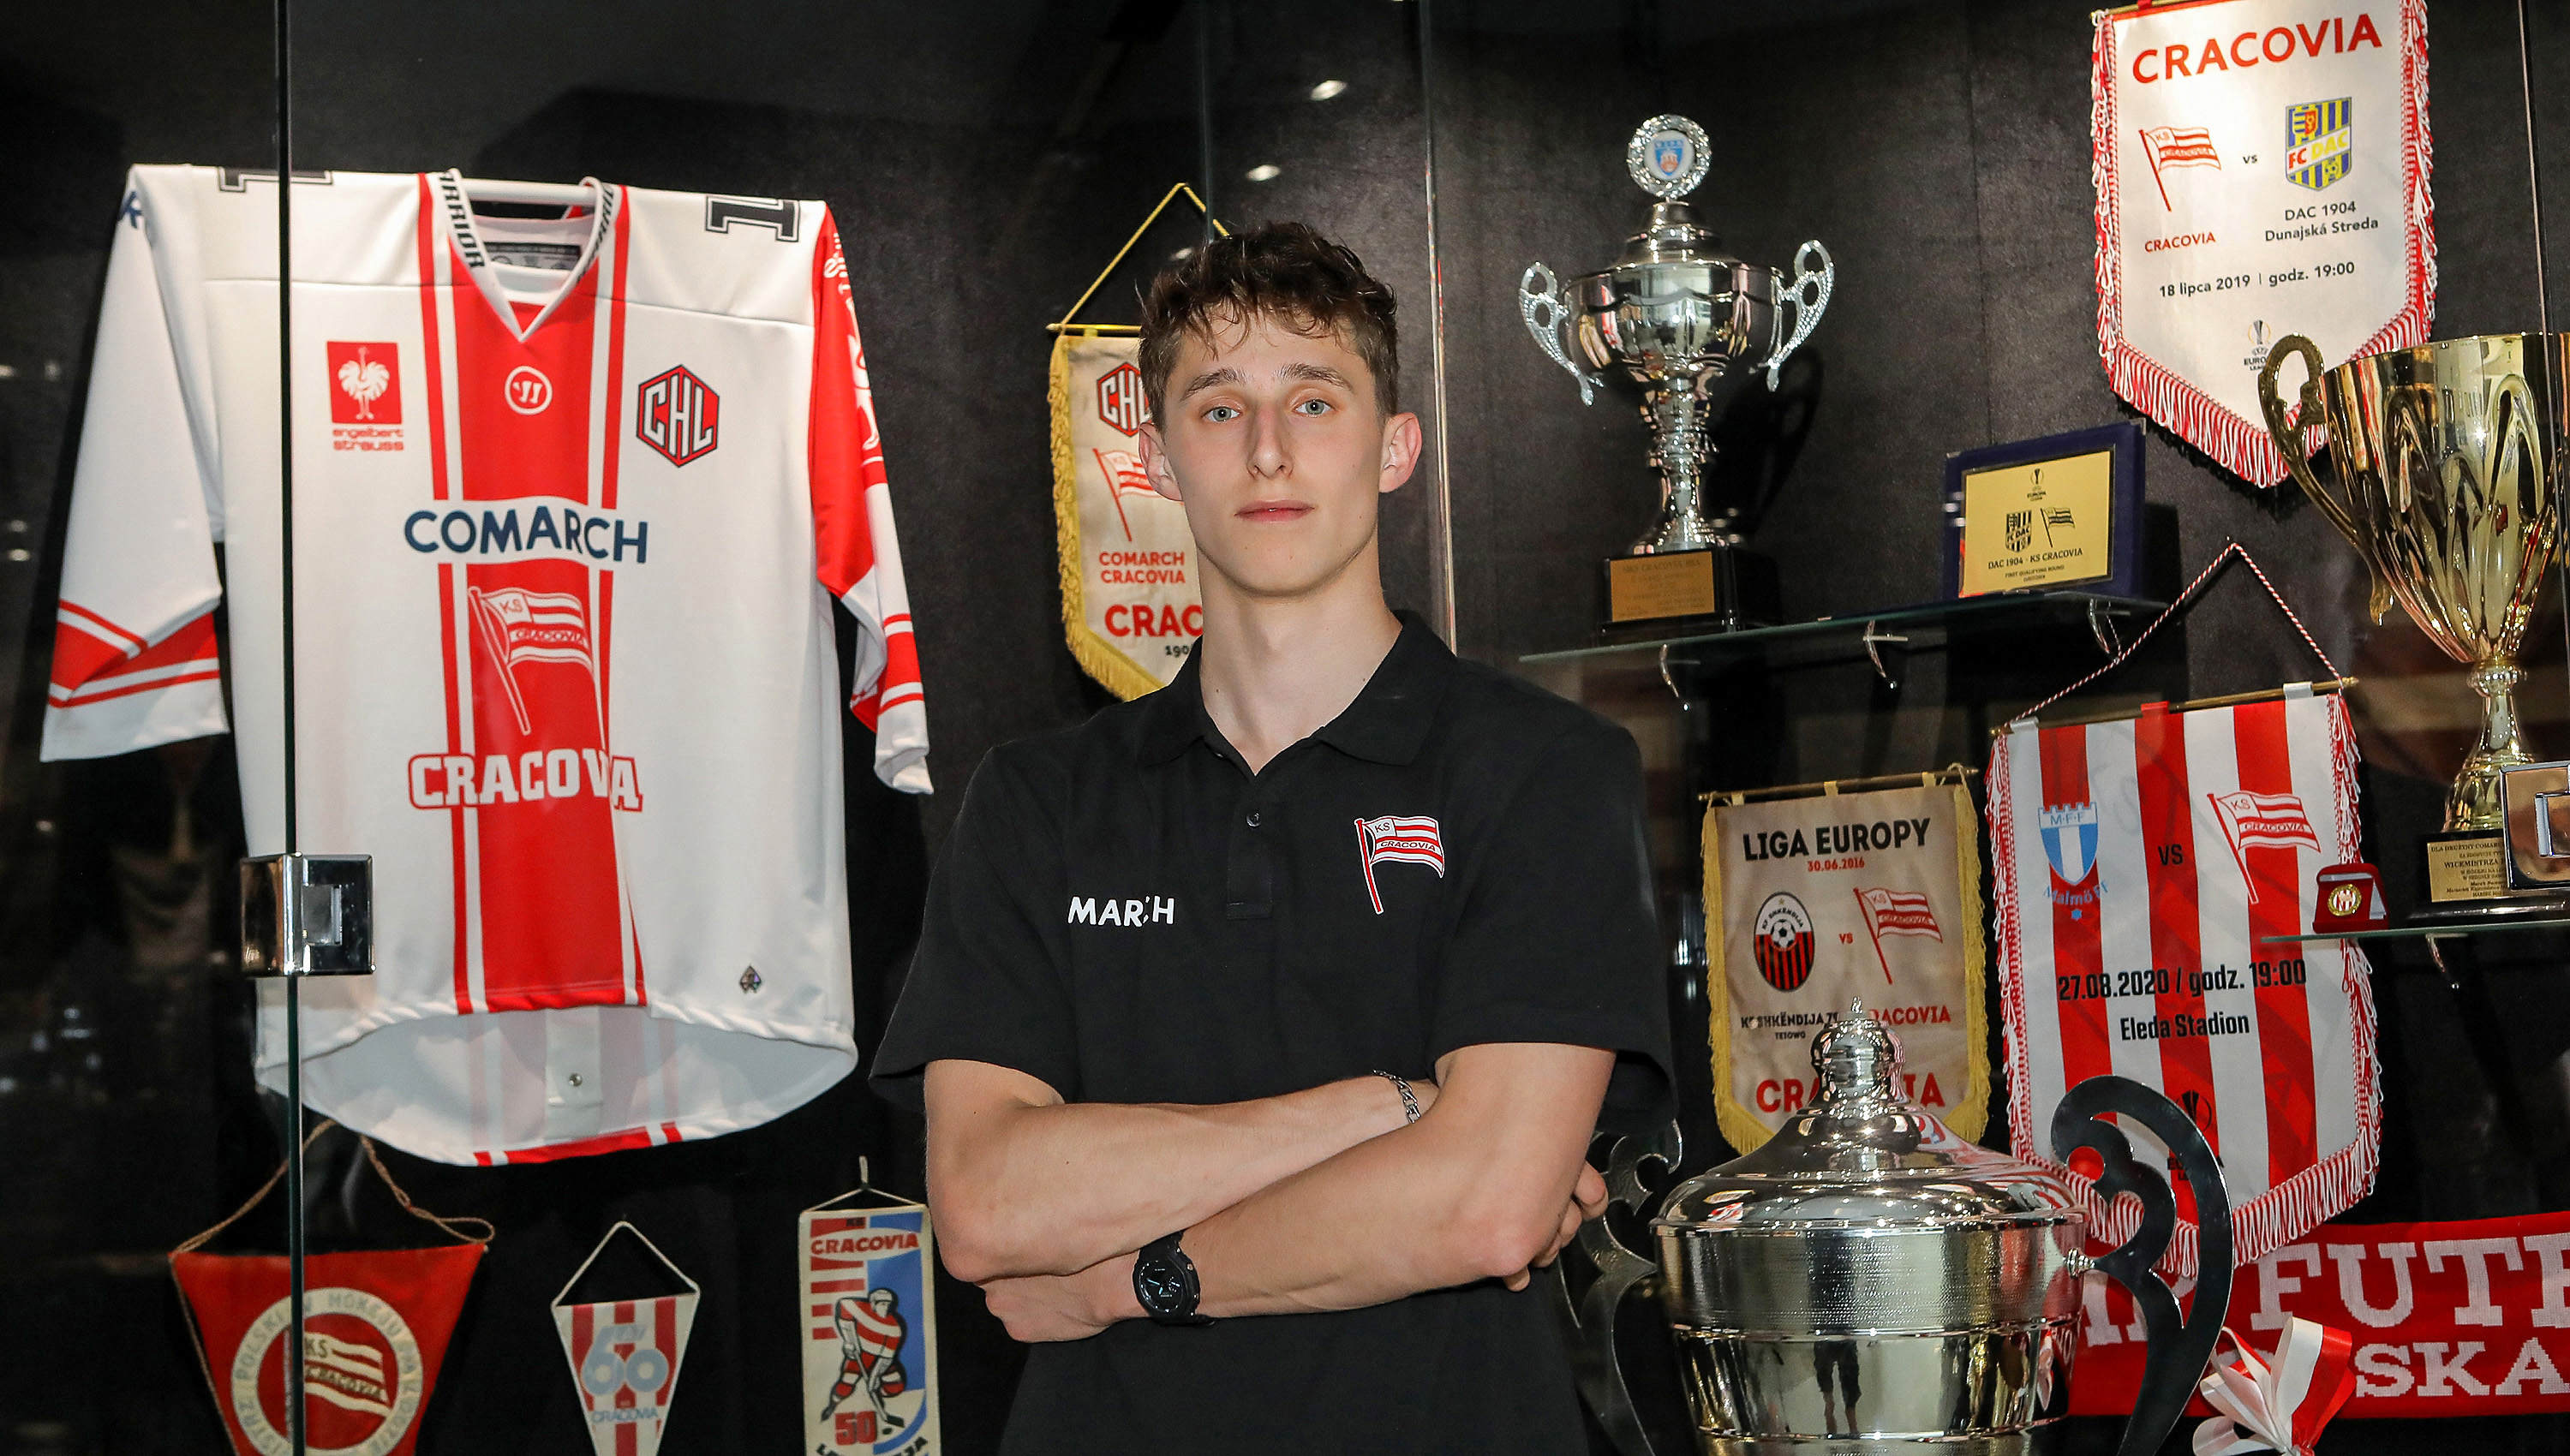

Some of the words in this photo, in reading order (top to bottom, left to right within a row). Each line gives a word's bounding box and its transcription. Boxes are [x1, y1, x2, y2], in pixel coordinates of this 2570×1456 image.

[2132, 13, 2383, 84] CRACOVIA
[2288, 146, 2307, 170] FC
[2310, 130, 2348, 160] DAC
[2285, 206, 2316, 221] DAC
[2322, 201, 2357, 218] 1904
[2264, 224, 2328, 242] Dunajská
[2332, 217, 2379, 234] Streda
[2144, 231, 2216, 254] CRACOVIA
[2160, 284, 2175, 297] 18
[2179, 281, 2211, 298] lipca
[2216, 275, 2250, 290] 2019
[2269, 268, 2310, 287] godz.
[2314, 261, 2355, 278] 19:00
[2244, 356, 2268, 366] EURO
[643, 374, 713, 459] CHL
[332, 440, 403, 451] strauss
[404, 505, 648, 564] COMARCH
[2016, 526, 2029, 538] DAC
[1099, 552, 1185, 567] COMARCH
[1988, 559, 2005, 570] DAC
[2006, 557, 2023, 566] 1904
[2030, 553, 2041, 563] KS
[2042, 547, 2083, 561] CRACOVIA
[1100, 570, 1186, 584] CRACOVIA
[499, 599, 523, 613] KS
[1105, 603, 1204, 638] CRAC
[1165, 644, 1192, 658] 190
[409, 748, 644, 813] CRACOVA
[2231, 797, 2251, 810] KS
[1374, 822, 1390, 832] KS
[2244, 823, 2305, 832] CRACOVIA
[1380, 841, 1436, 852] CRACOVIA
[1742, 828, 1810, 862] LIGA
[1815, 817, 1931, 855] EUROPY
[1808, 857, 1865, 872] 30.06.2016
[2158, 844, 2184, 866] VS
[2444, 858, 2498, 868] WICEMISTRZA
[2058, 969, 2170, 1000] 27.08.2020
[2189, 964, 2245, 998] godz.
[2249, 958, 2307, 988] 19:00
[1868, 1004, 1951, 1026] ACOVIA
[2120, 1015, 2172, 1041] Eleda
[2174, 1011, 2250, 1037] Stadion
[810, 1232, 919, 1255] CRACOVIA
[834, 1410, 877, 1446] 50
